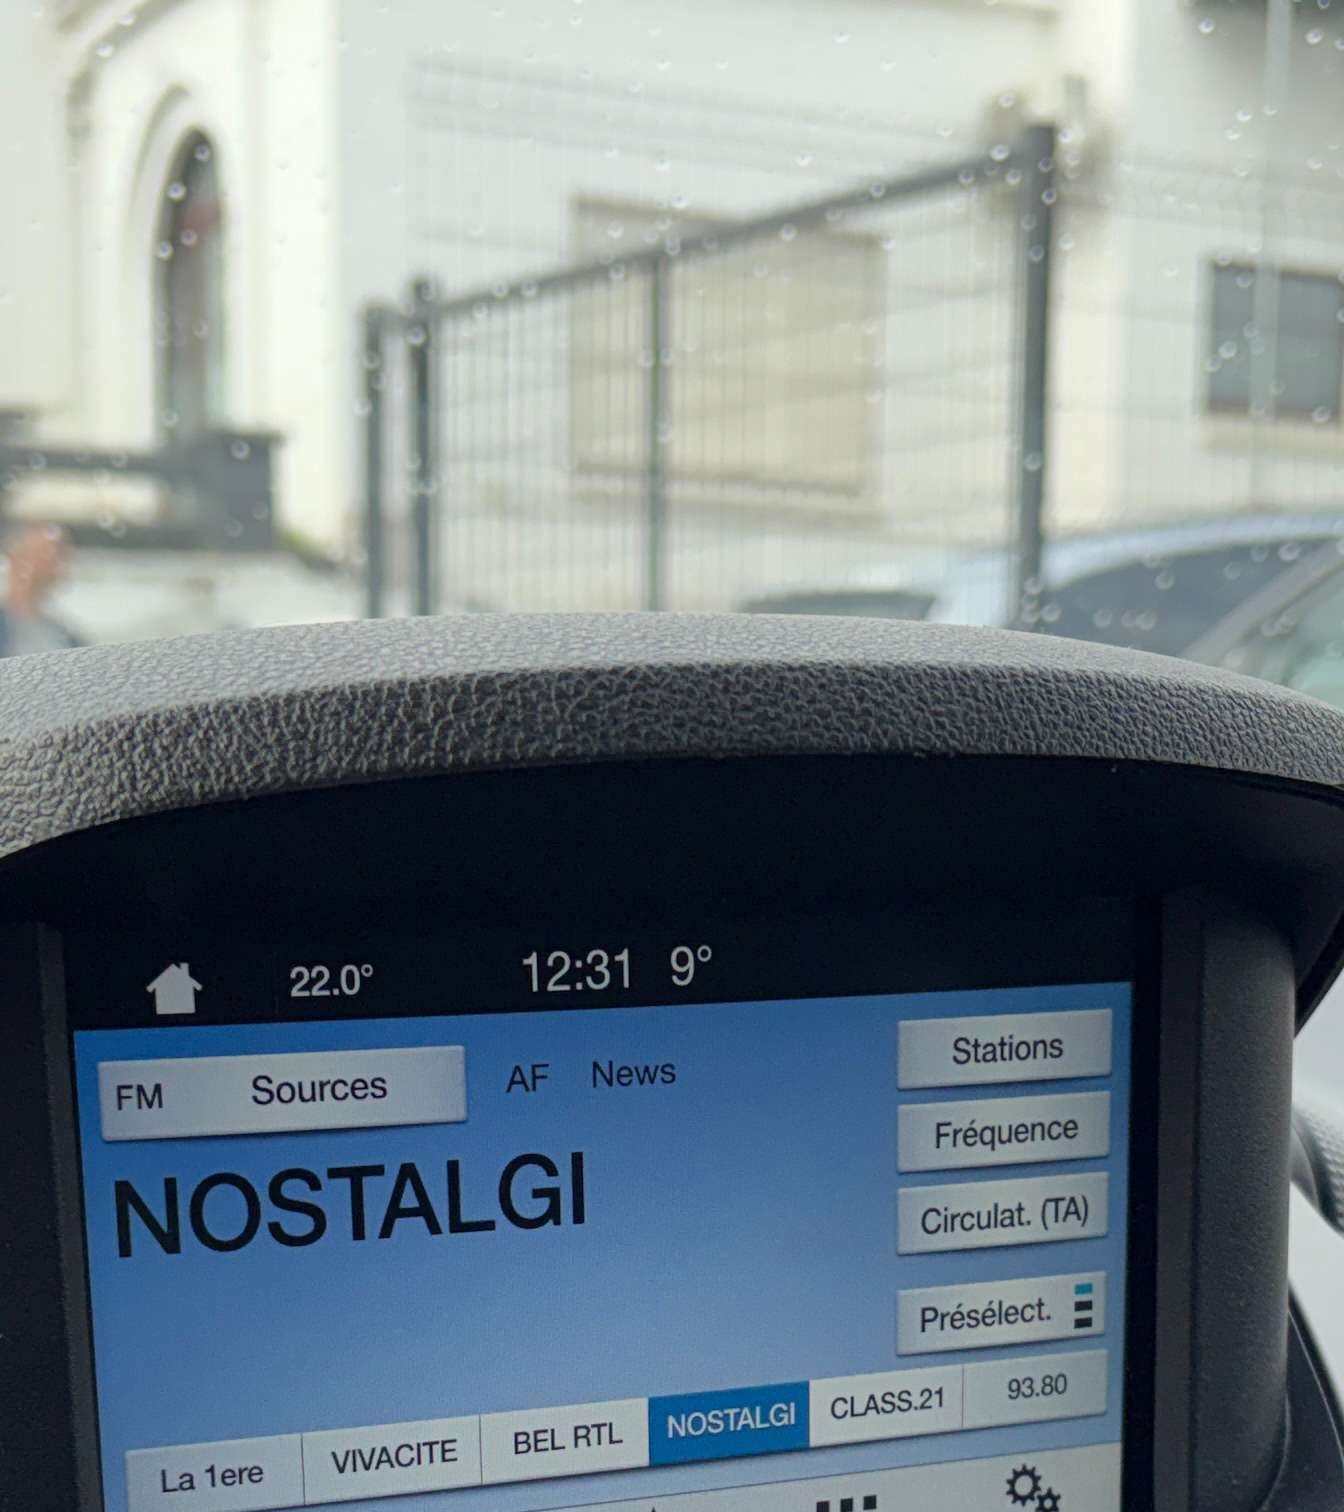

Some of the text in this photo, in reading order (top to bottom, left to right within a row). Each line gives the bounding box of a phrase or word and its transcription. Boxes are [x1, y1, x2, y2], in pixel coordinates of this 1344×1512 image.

[289, 963, 374, 997] 22.0°
[522, 948, 631, 993] 12:31
[670, 945, 712, 987] 9°
[952, 1034, 1064, 1065] Stations
[251, 1073, 388, 1106] Sources
[506, 1064, 550, 1094] AF
[592, 1060, 676, 1088] News
[116, 1084, 164, 1111] FM
[935, 1115, 1079, 1151] Fréquence
[114, 1150, 586, 1258] NOSTALGI
[921, 1195, 1089, 1236] Circulat. (TA)
[920, 1300, 1051, 1333] Présélect.
[1007, 1373, 1068, 1400] 93.80
[830, 1387, 944, 1420] CLASS.21
[668, 1402, 796, 1439] NOSTALGI
[513, 1422, 623, 1456] BEL RTL
[331, 1439, 458, 1474] VIVACITE
[160, 1464, 264, 1494] La 1ere
